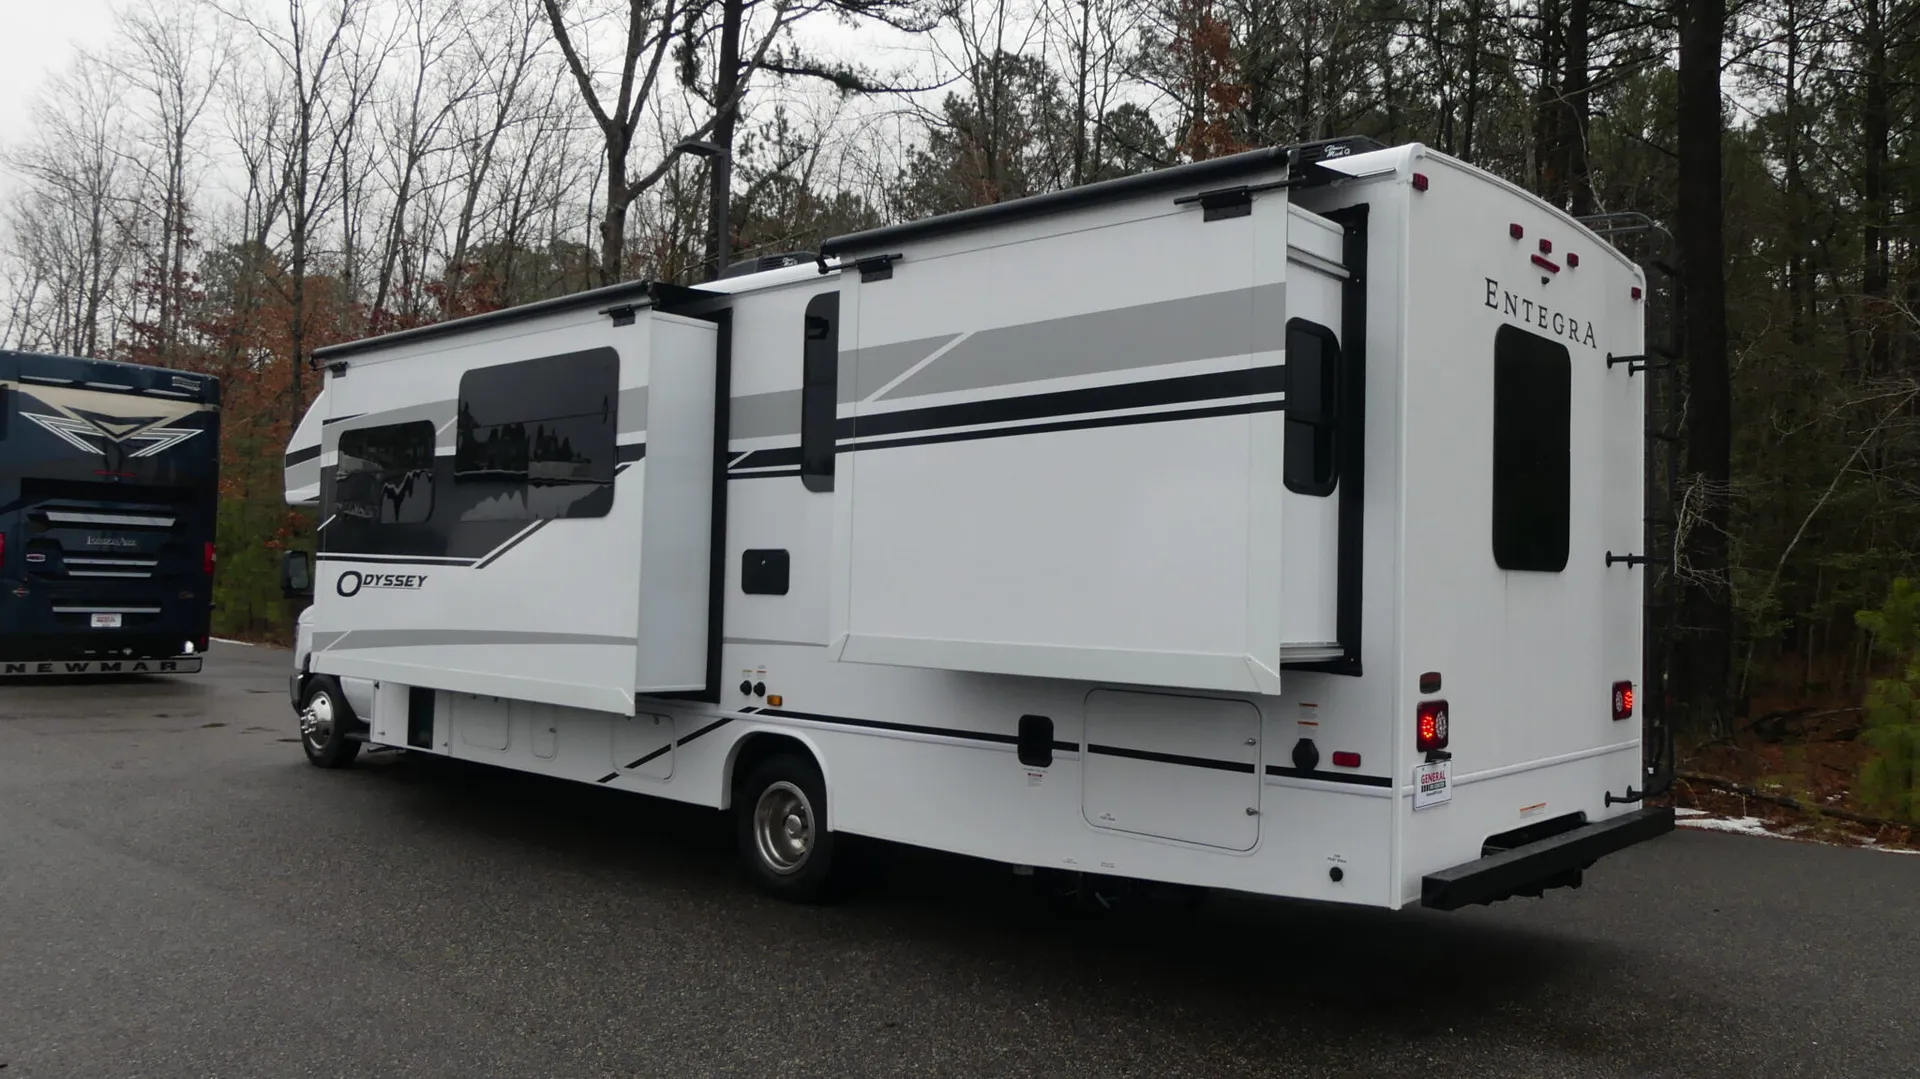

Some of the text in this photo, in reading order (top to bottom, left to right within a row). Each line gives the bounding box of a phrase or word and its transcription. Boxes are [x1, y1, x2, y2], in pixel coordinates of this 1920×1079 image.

[1484, 276, 1597, 349] ENTEGRA
[336, 570, 428, 597] ODYSSEY
[5, 661, 178, 674] NEWMAR
[1421, 770, 1446, 785] GENERAL
